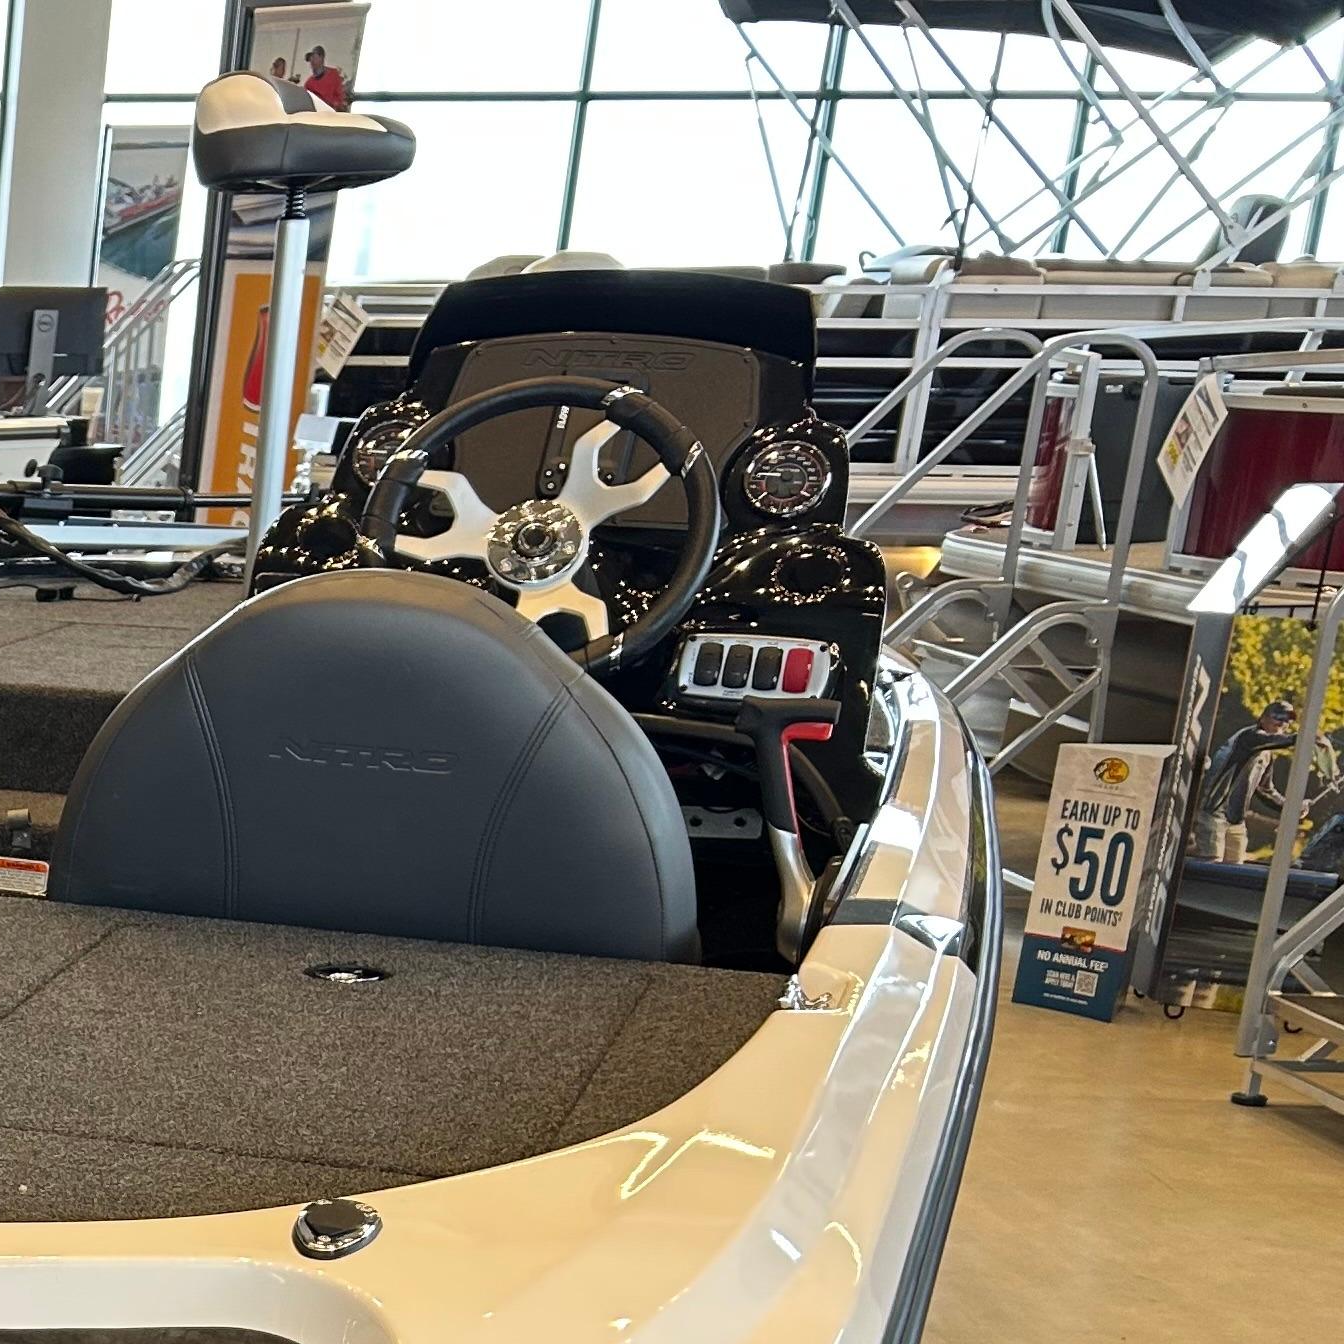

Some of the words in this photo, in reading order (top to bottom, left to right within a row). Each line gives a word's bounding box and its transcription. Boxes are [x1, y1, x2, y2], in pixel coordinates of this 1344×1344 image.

[523, 348, 696, 371] NITRO
[268, 736, 458, 775] NITRO
[1060, 799, 1099, 824] EARN
[1102, 805, 1121, 827] UP
[1124, 808, 1141, 830] TO
[1051, 823, 1135, 907] $50
[1040, 898, 1053, 915] IN
[1055, 900, 1082, 920] CLUB
[1036, 949, 1052, 961] NO
[1052, 952, 1088, 969] ANNUAL
